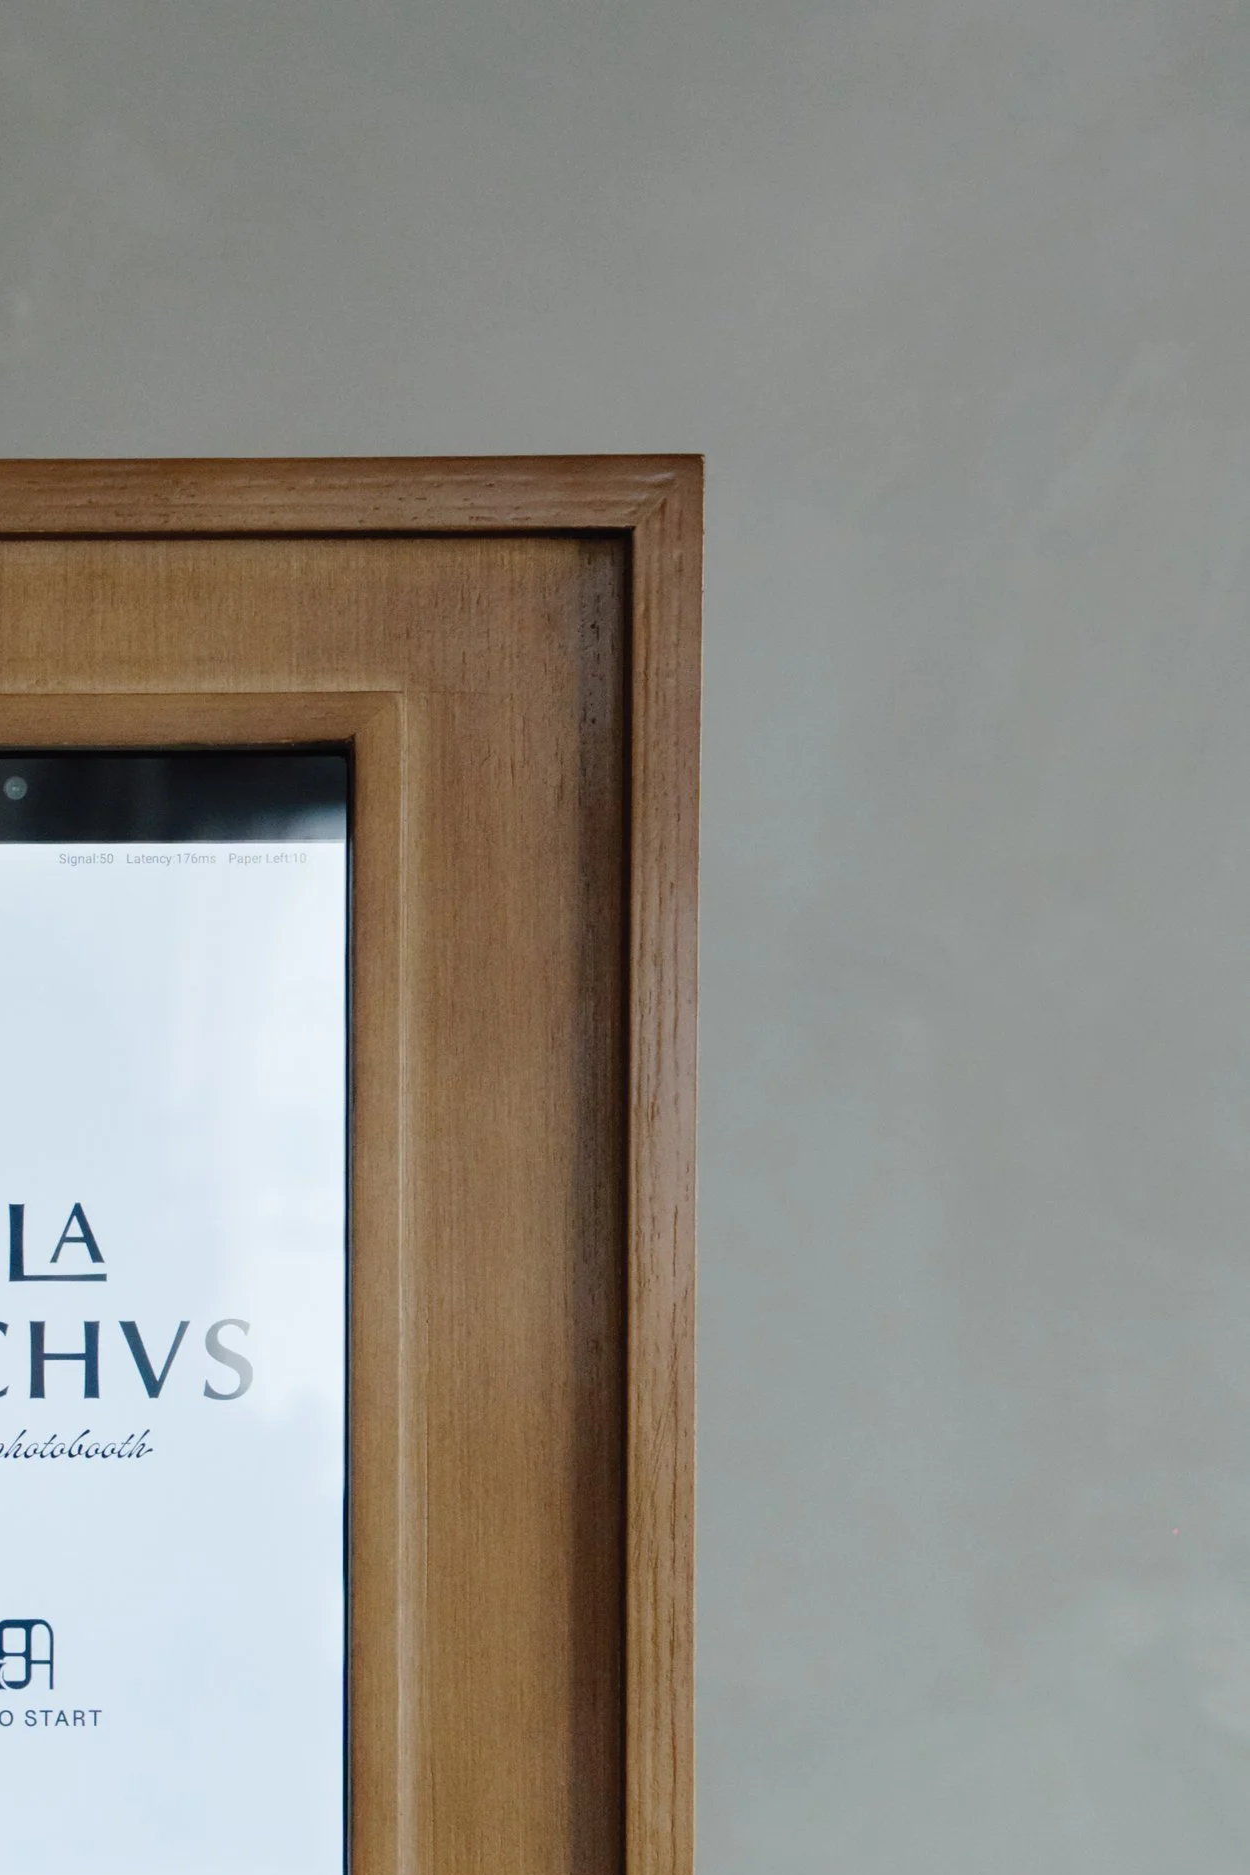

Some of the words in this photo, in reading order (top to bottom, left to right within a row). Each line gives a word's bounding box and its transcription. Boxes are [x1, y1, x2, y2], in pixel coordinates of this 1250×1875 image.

[58, 853, 115, 867] Signal:50
[126, 853, 217, 868] Latency:176ms
[228, 853, 262, 867] Paper
[266, 853, 307, 865] Left:10
[24, 1709, 103, 1728] START
